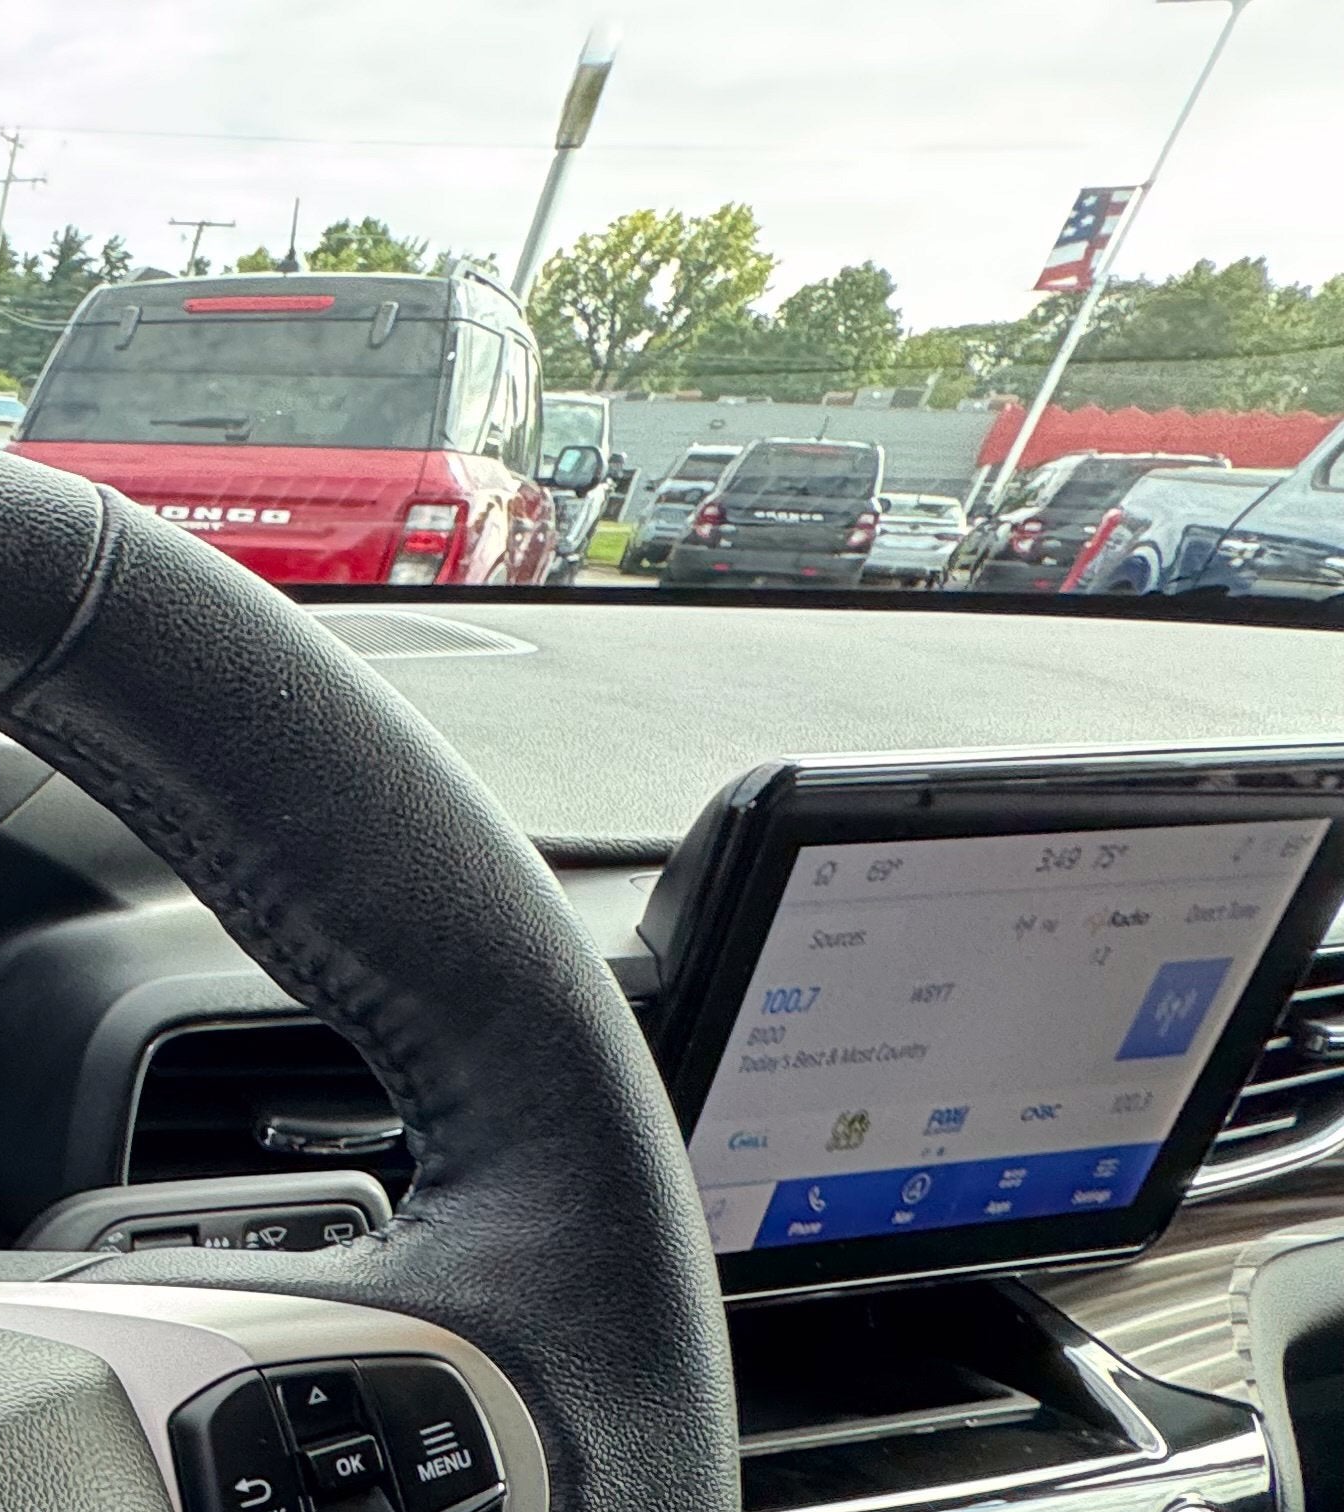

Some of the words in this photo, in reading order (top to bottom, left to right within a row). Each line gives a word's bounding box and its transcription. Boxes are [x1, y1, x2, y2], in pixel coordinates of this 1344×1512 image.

[762, 986, 821, 1014] 100.7
[336, 1454, 366, 1478] OK
[417, 1449, 472, 1482] MENU
